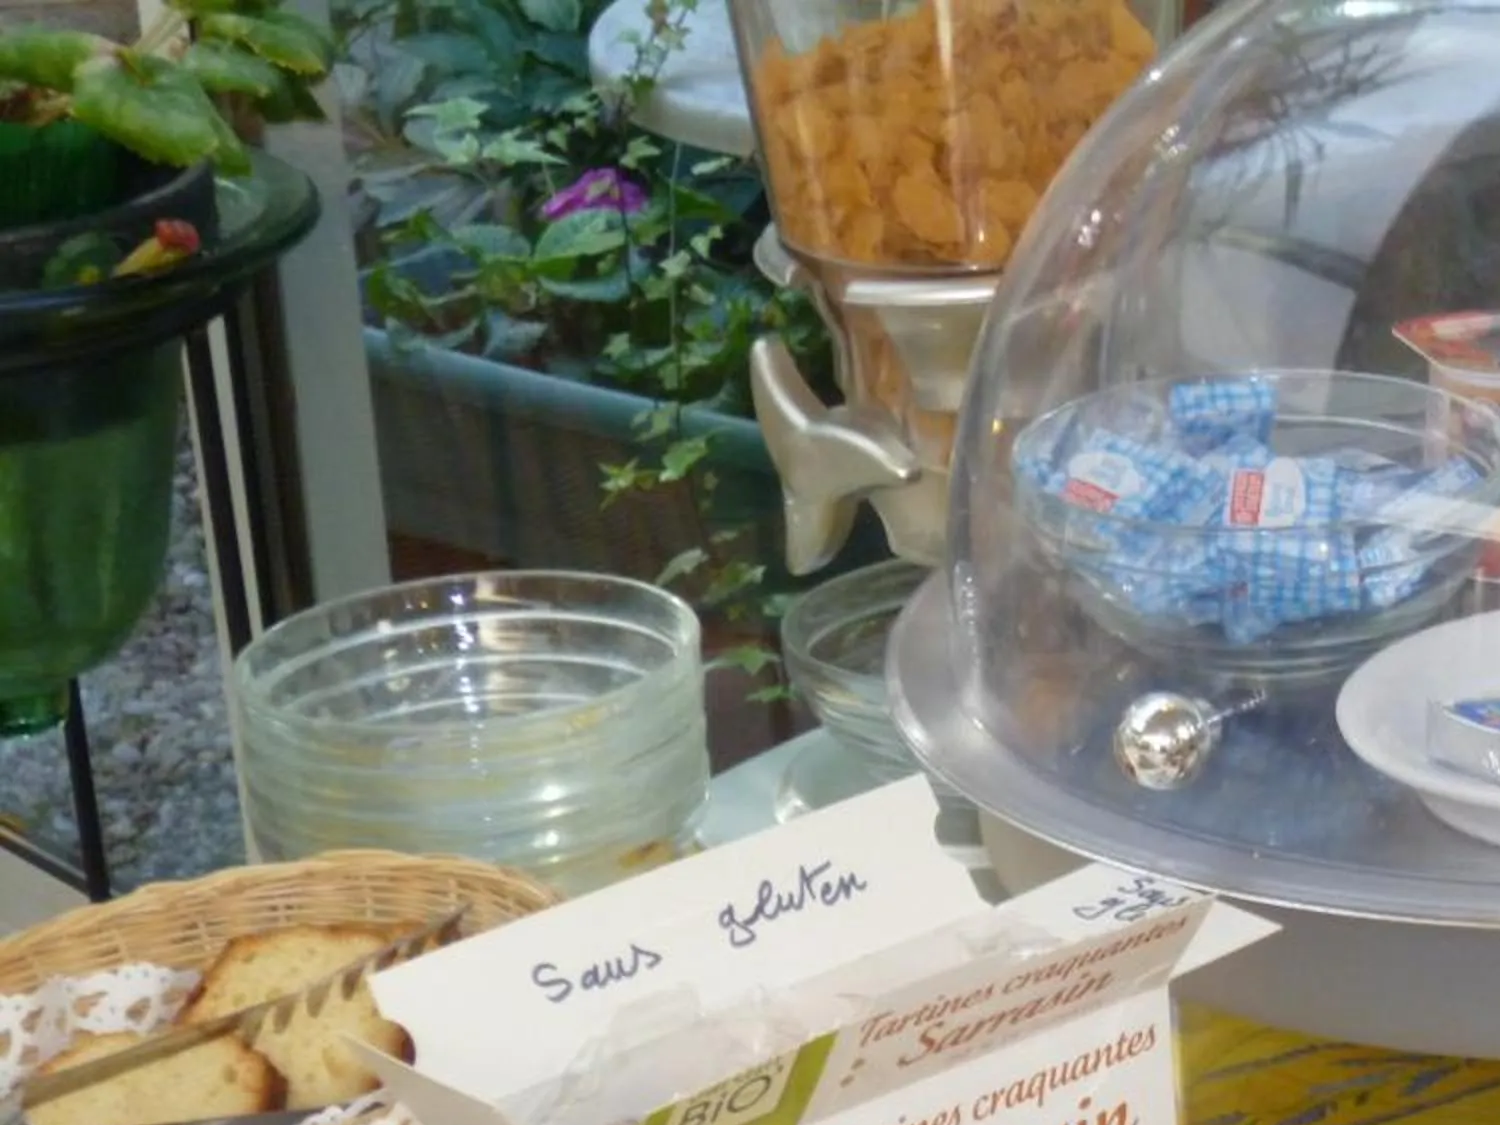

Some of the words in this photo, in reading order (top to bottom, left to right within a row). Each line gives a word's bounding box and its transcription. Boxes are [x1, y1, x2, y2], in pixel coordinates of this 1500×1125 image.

[717, 860, 868, 949] gluten
[858, 981, 995, 1048] Tartines
[1002, 915, 1188, 997] craquantes
[896, 972, 1115, 1067] Sarrasin
[971, 1023, 1157, 1122] craquantes
